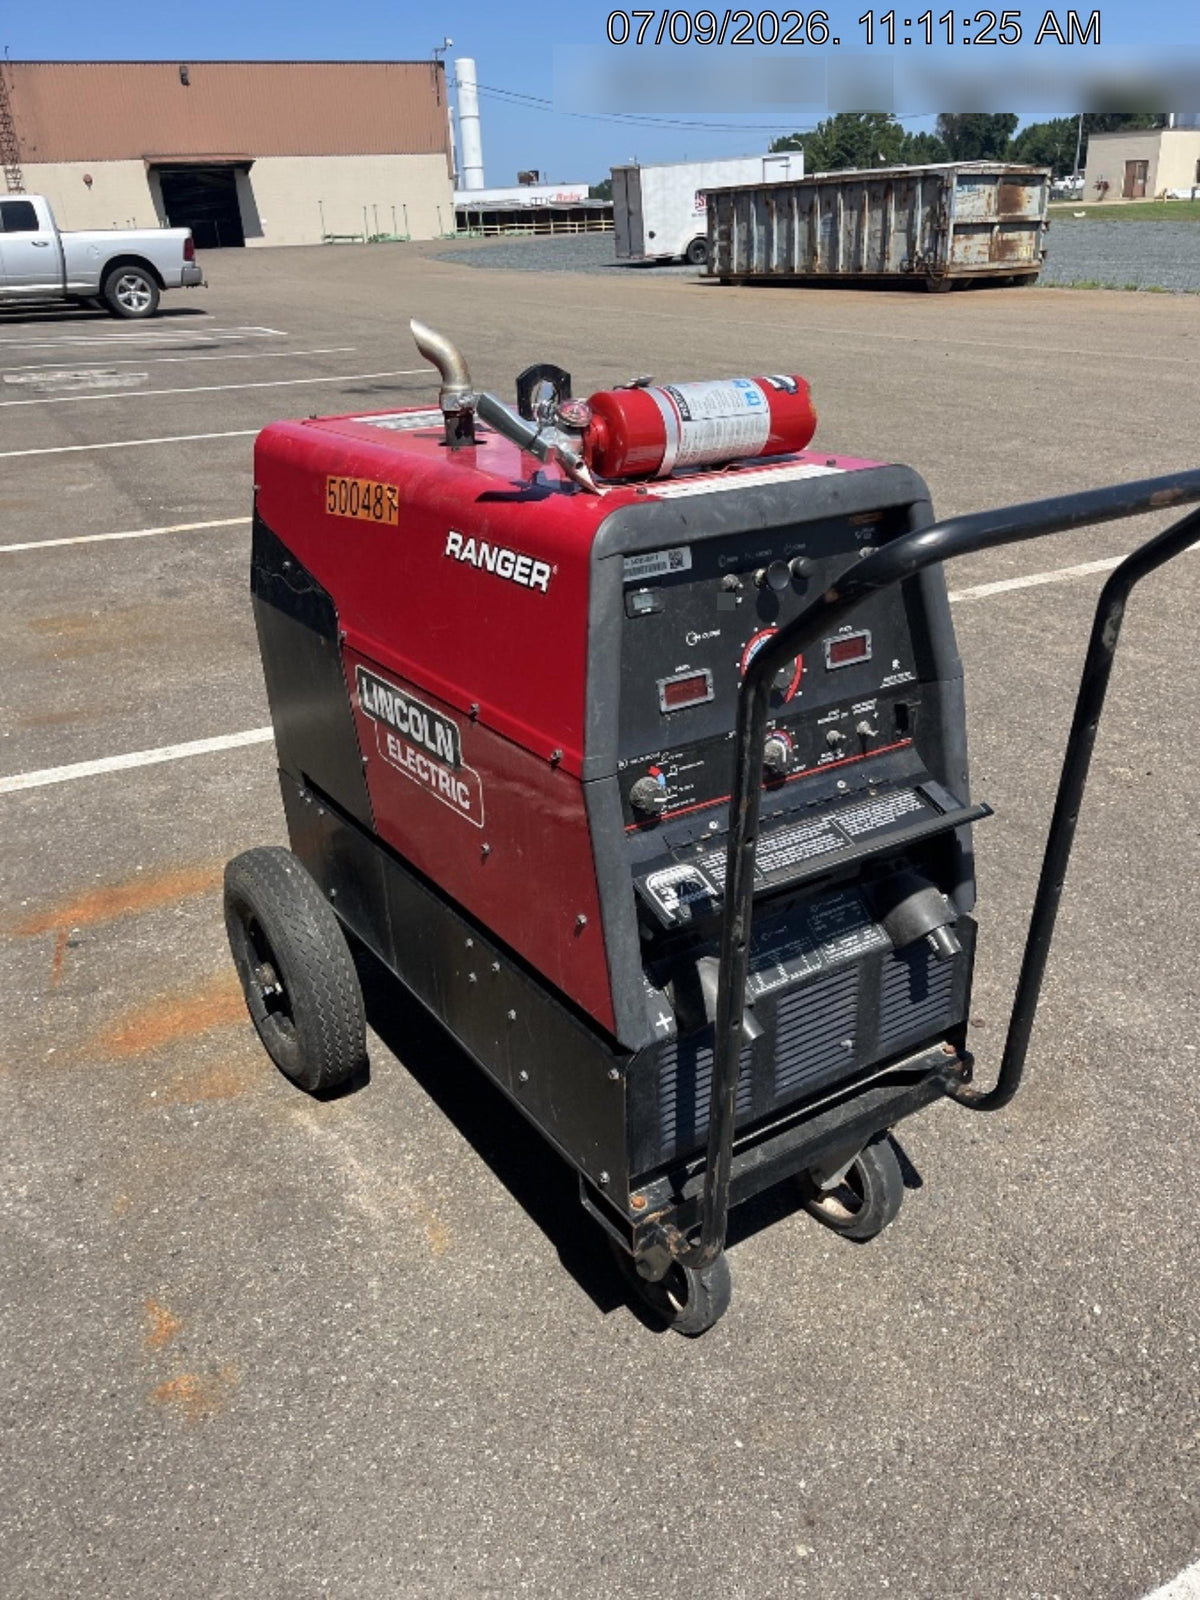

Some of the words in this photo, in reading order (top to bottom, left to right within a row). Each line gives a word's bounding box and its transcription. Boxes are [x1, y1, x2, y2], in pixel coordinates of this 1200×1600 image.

[445, 530, 551, 593] RANGER
[361, 676, 455, 764] LINCOLN
[386, 732, 471, 810] ELECTRIC
